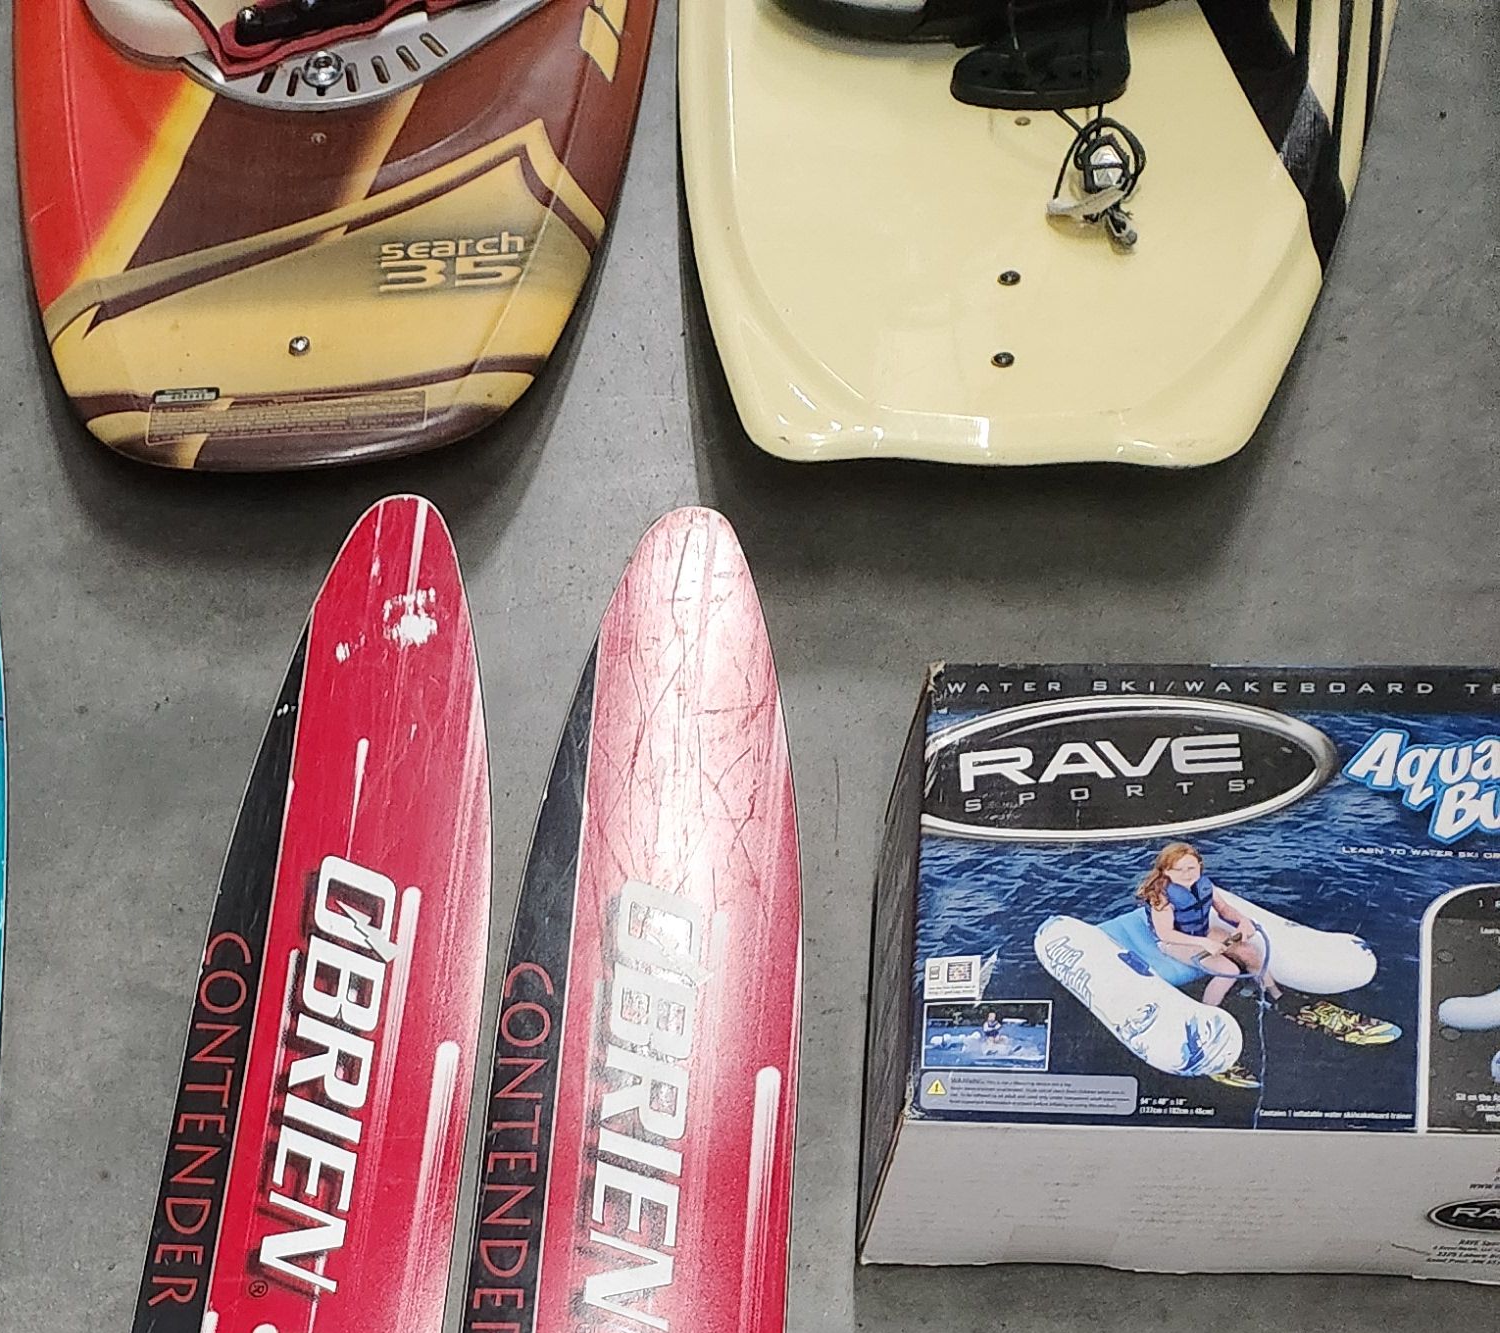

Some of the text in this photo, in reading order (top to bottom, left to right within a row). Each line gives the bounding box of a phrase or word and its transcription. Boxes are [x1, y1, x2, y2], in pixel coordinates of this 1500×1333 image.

[380, 231, 525, 260] search
[380, 253, 522, 291] 35
[947, 681, 1061, 693] WATER
[1093, 680, 1433, 694] SKI/WAKEBOARD
[960, 733, 1243, 792] RAVE
[964, 778, 1248, 812] SPORTS
[1341, 846, 1384, 855] LEARN
[1389, 848, 1406, 856] TO
[1411, 849, 1453, 858] WATER
[148, 931, 252, 1308] CONTENDER
